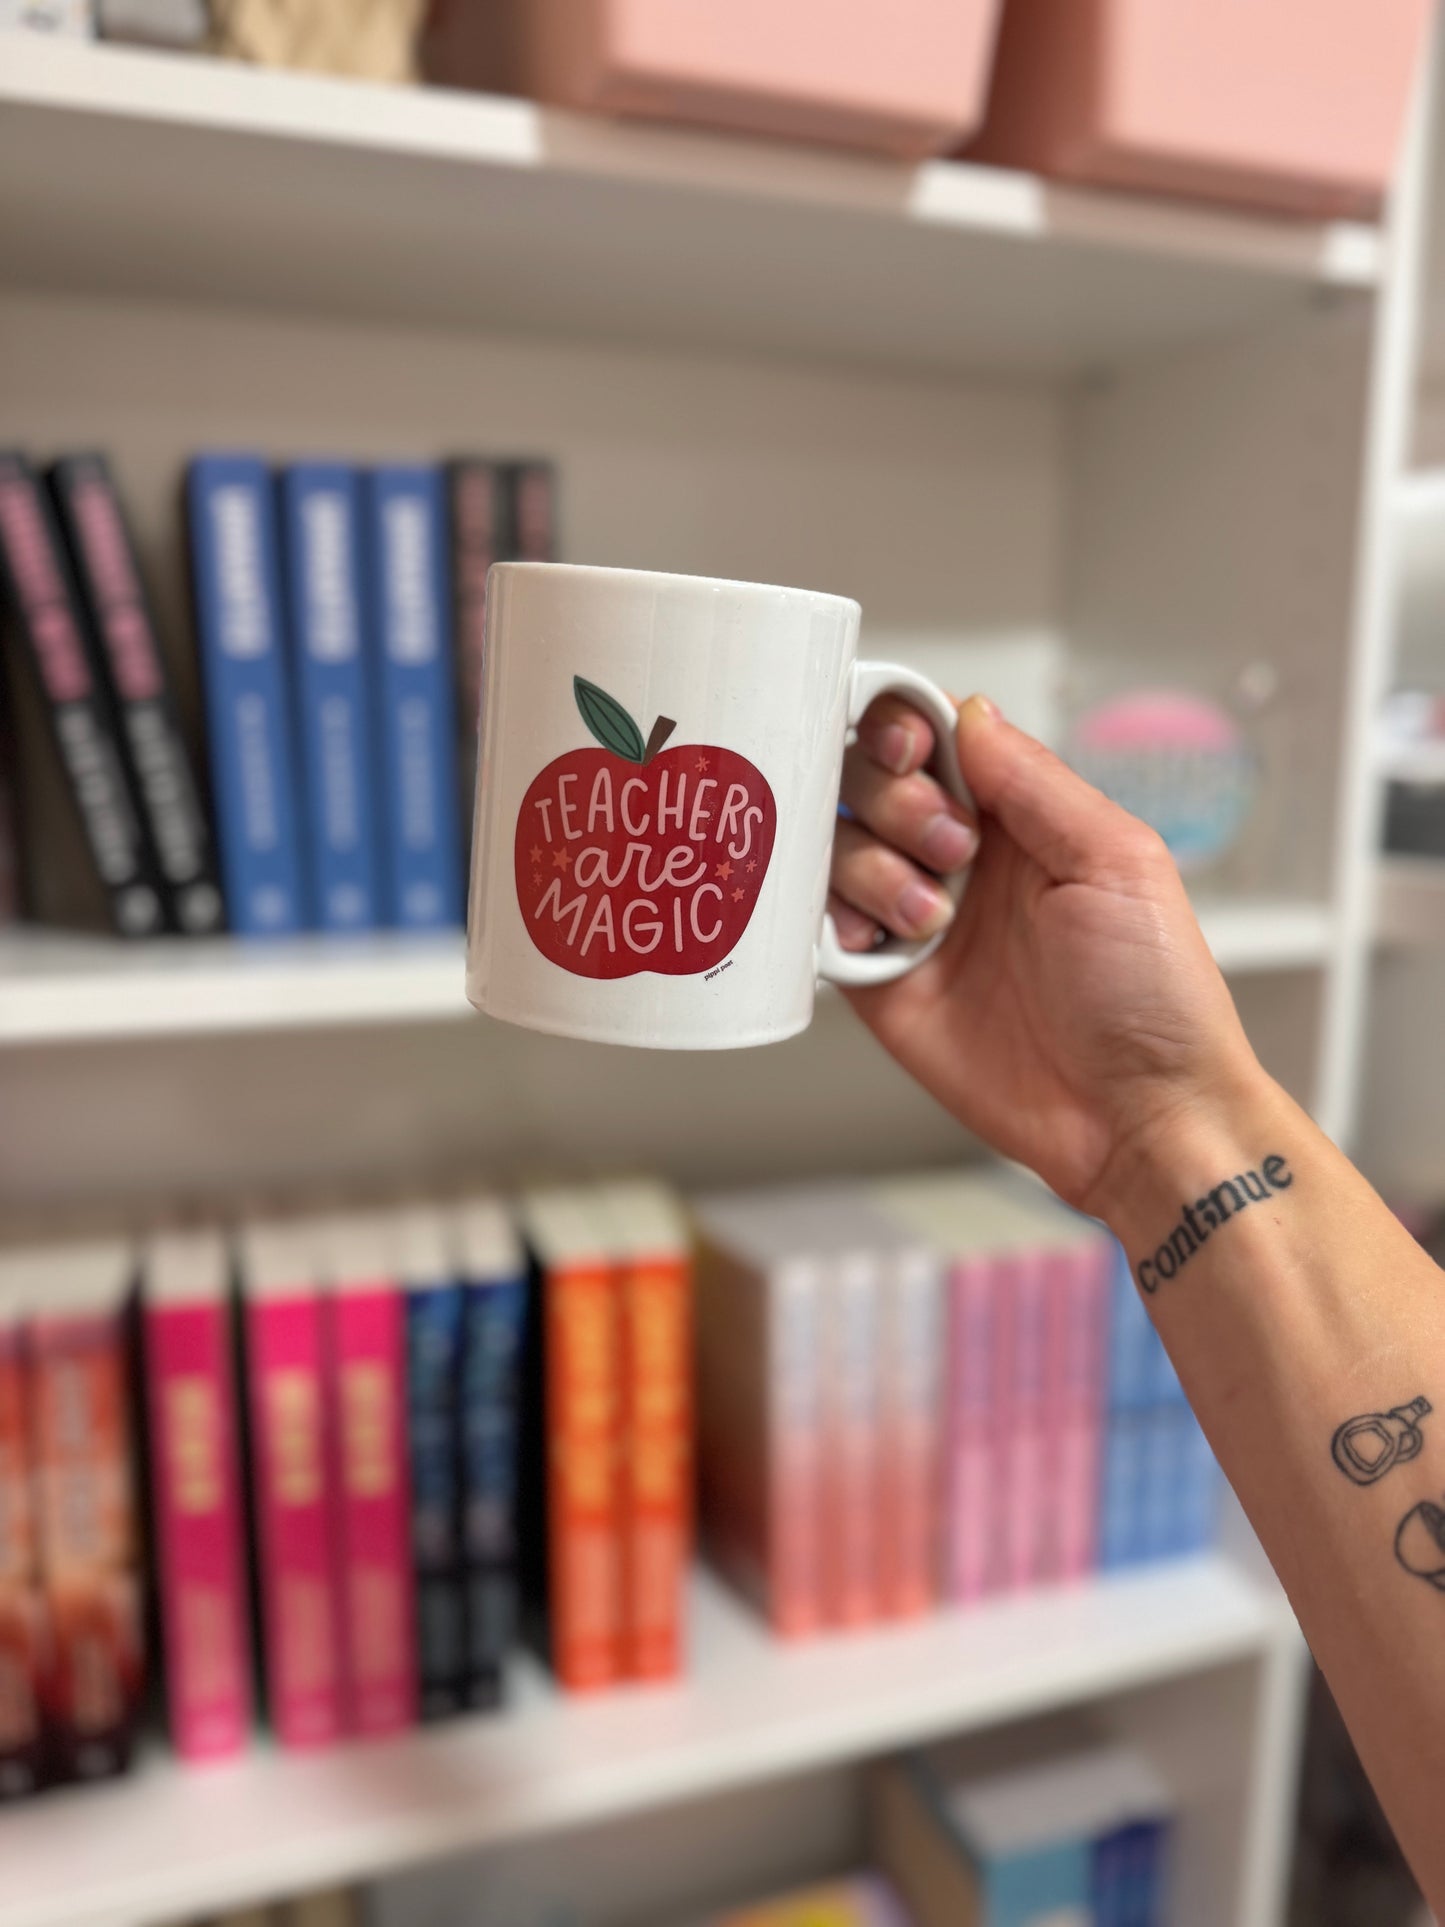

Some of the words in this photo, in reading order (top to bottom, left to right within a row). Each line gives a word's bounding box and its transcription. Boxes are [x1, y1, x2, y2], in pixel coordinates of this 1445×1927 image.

[535, 767, 763, 859] TEACHERS
[574, 842, 707, 892] are
[535, 878, 723, 956] MAGIC
